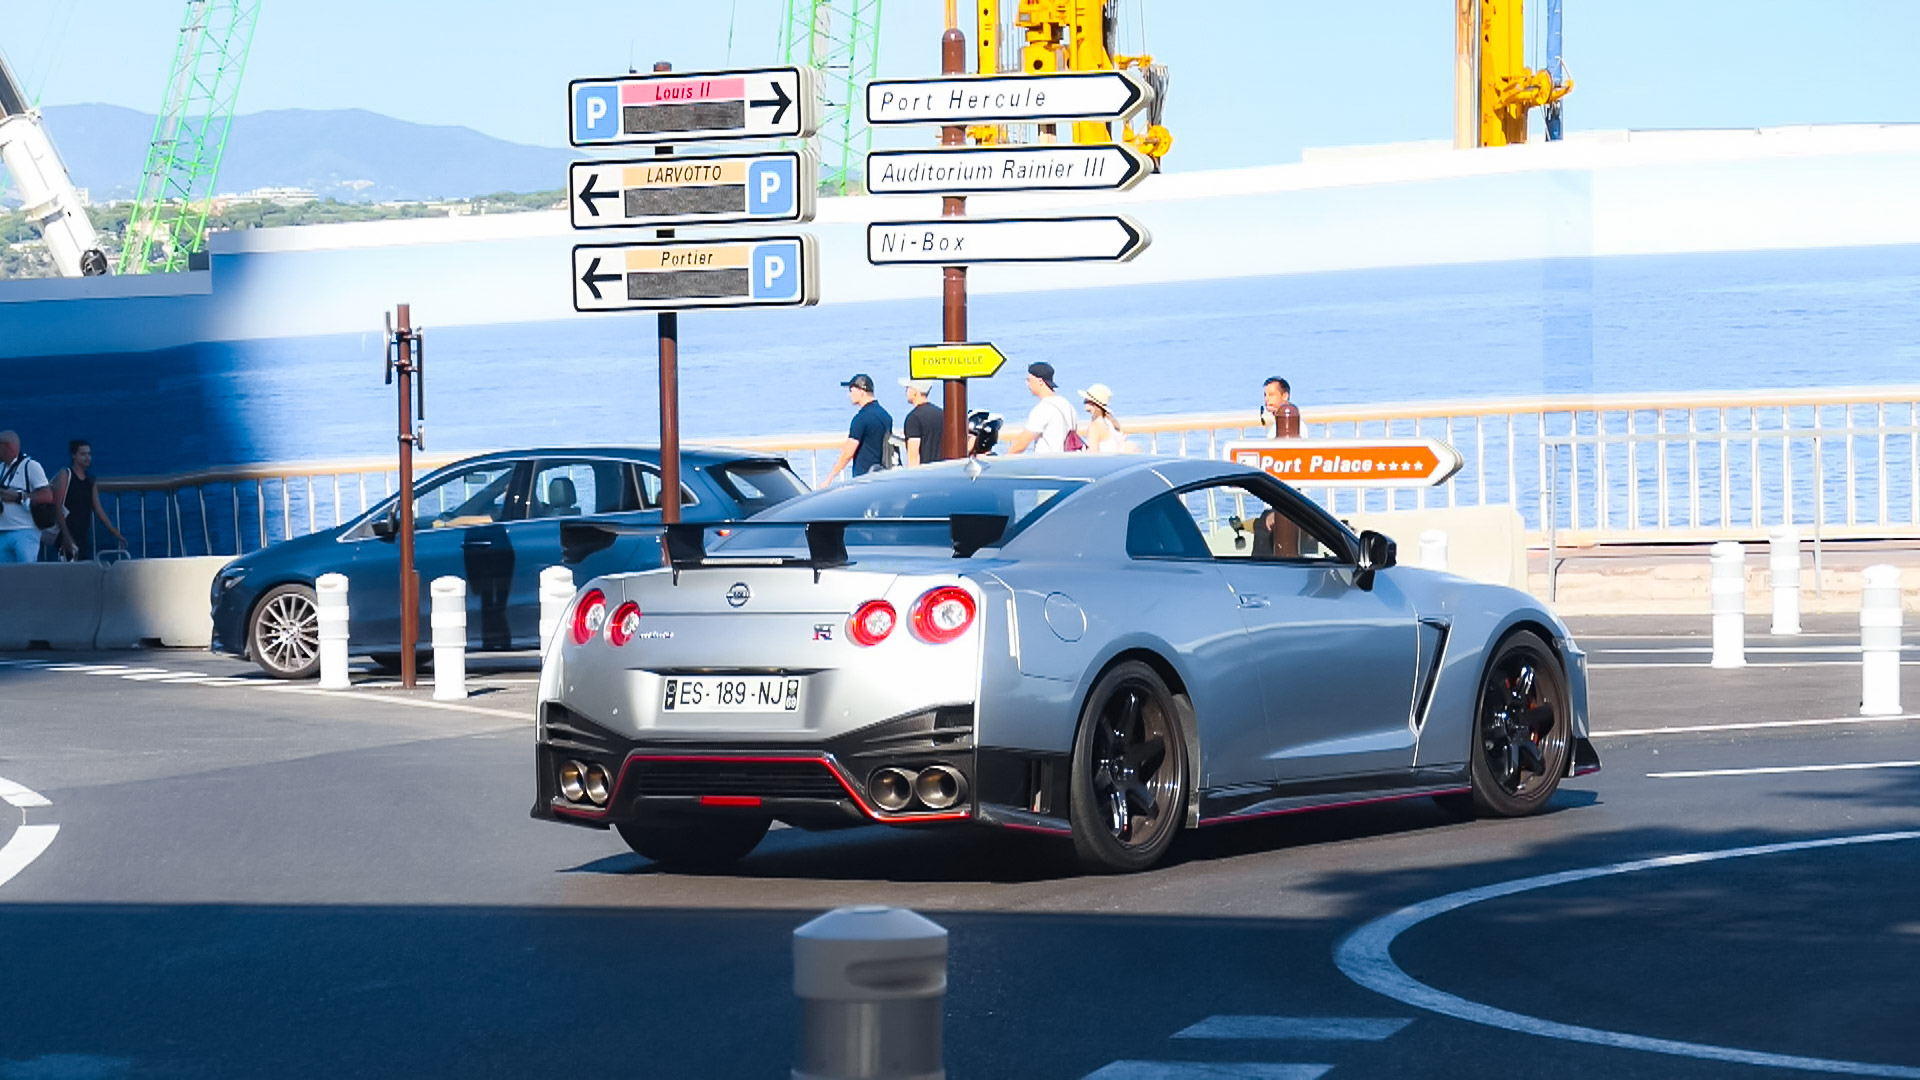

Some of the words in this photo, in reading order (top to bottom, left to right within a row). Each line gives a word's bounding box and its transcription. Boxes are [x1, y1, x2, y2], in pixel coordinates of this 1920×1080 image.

[655, 84, 693, 101] Louis
[881, 91, 933, 113] Port
[949, 87, 1046, 110] Hercule
[646, 165, 722, 184] LARVOTTO
[881, 160, 994, 183] Auditorium
[1002, 158, 1075, 180] Rainier
[1083, 156, 1106, 178] III
[881, 231, 965, 253] Ni-Box
[660, 250, 714, 267] Portier
[1260, 455, 1303, 473] Port
[1309, 455, 1374, 474] Palace
